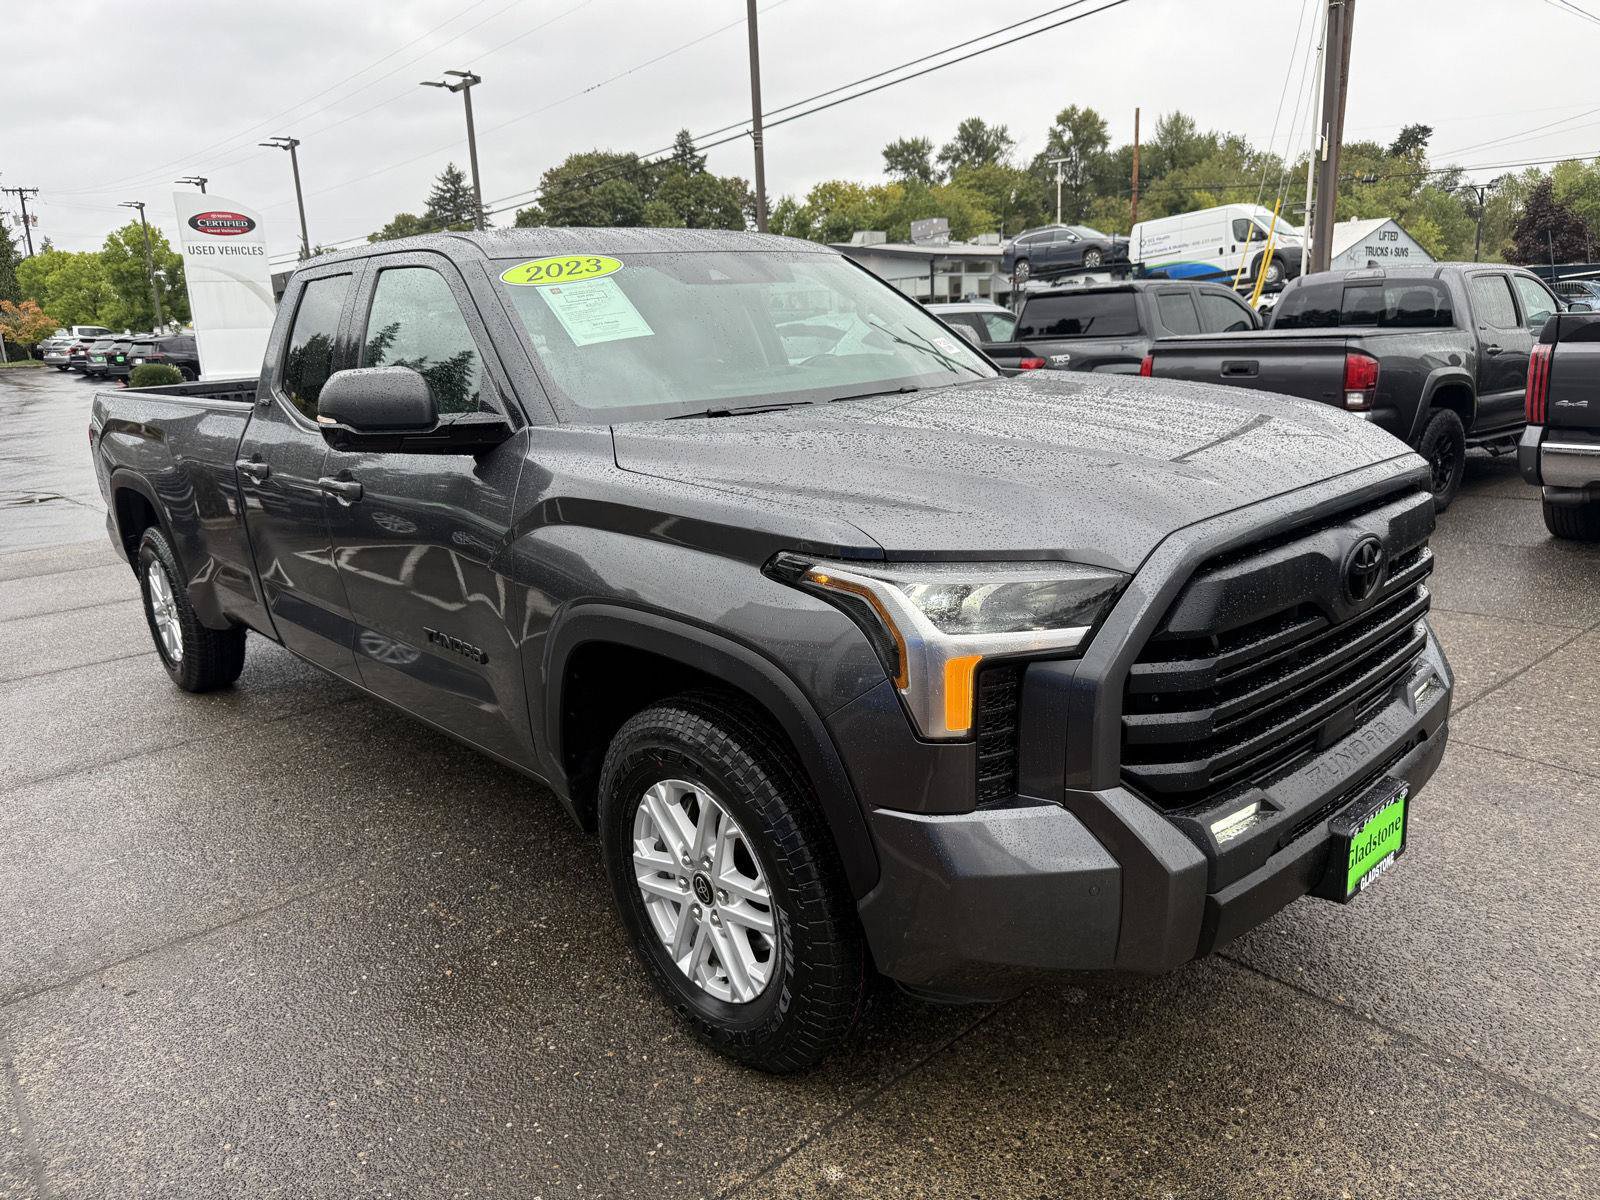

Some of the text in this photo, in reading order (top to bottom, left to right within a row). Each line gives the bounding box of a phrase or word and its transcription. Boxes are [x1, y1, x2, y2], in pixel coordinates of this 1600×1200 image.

[197, 219, 248, 227] CERTIFIED
[1378, 231, 1399, 241] LIFTED
[187, 245, 264, 256] USED VEHICLES
[1364, 246, 1389, 257] TRUCKS
[525, 258, 603, 282] 2023
[1050, 354, 1070, 362] TRD
[1304, 720, 1398, 784] TUNDRA
[1348, 815, 1402, 871] Gladstone
